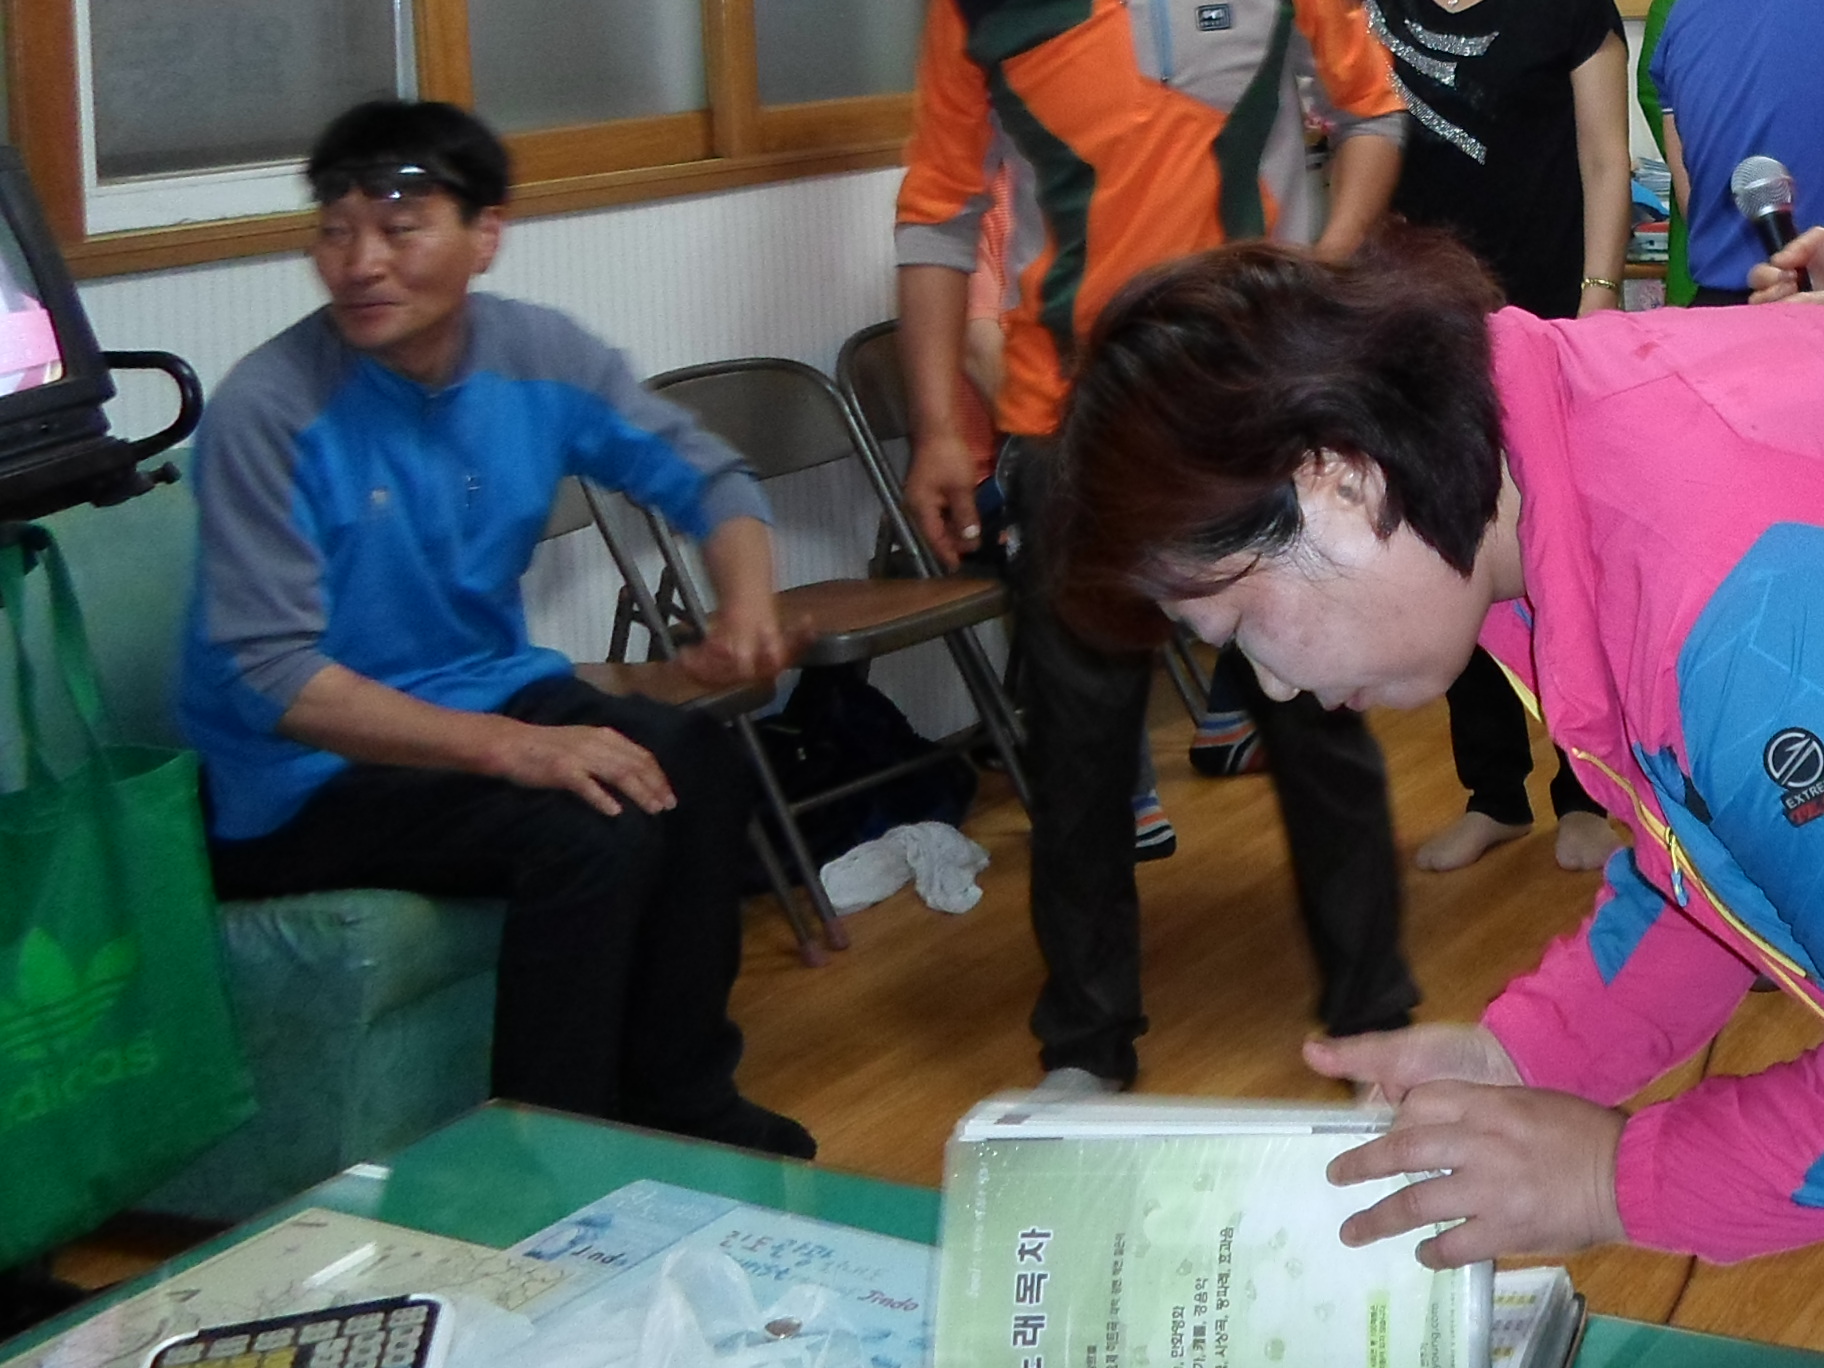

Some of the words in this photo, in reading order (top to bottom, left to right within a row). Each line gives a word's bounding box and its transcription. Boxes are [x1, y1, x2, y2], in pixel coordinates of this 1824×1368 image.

[1218, 1227, 1234, 1264] 효과음
[1193, 1277, 1208, 1317] 경음악
[1171, 1306, 1186, 1358] 만화영화
